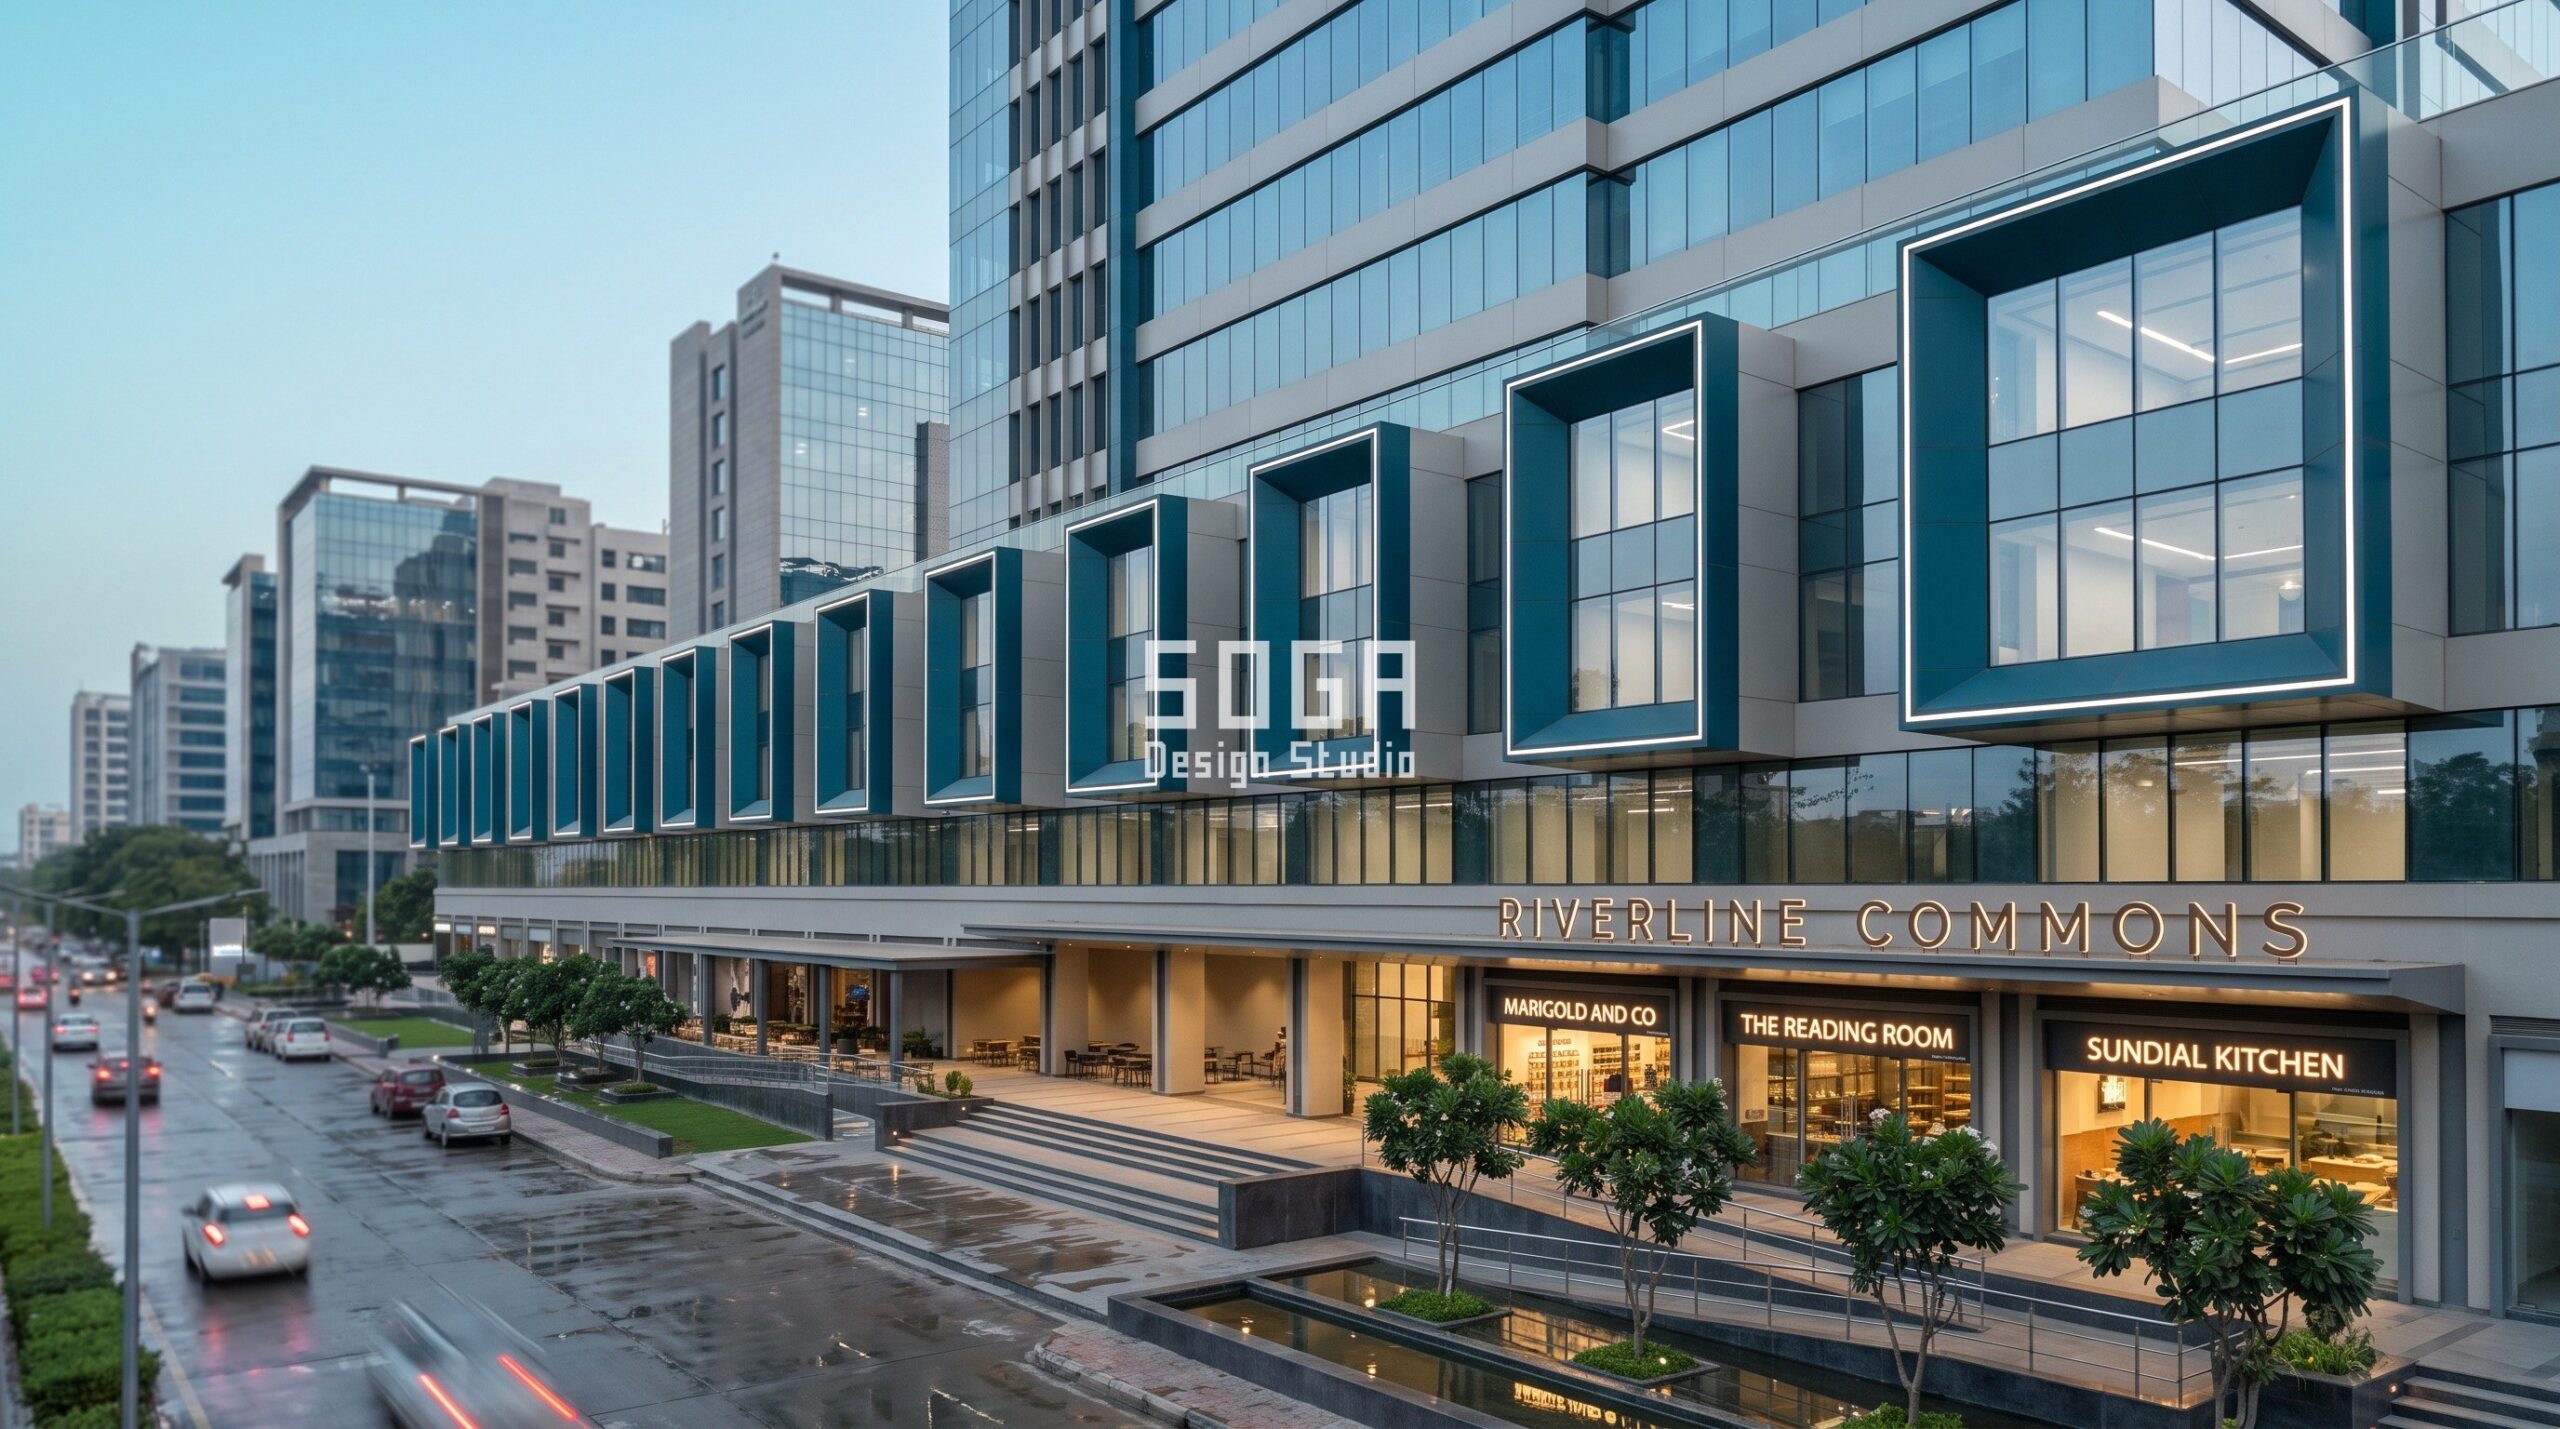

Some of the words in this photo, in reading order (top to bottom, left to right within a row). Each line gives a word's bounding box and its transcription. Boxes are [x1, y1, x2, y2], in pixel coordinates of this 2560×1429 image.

[1499, 897, 1807, 947] RIVERLINE
[1856, 899, 2309, 959] COMMONS
[1504, 998, 1588, 1021] MARIGOLD
[1590, 1005, 1628, 1024] AND
[1631, 1006, 1657, 1026] CO
[1740, 1013, 1779, 1036] THE
[1784, 1017, 1877, 1044] READING
[1883, 1024, 1953, 1049] ROOM
[2087, 1037, 2207, 1069] SUNDIAL
[2215, 1046, 2345, 1079] KITCHEN
